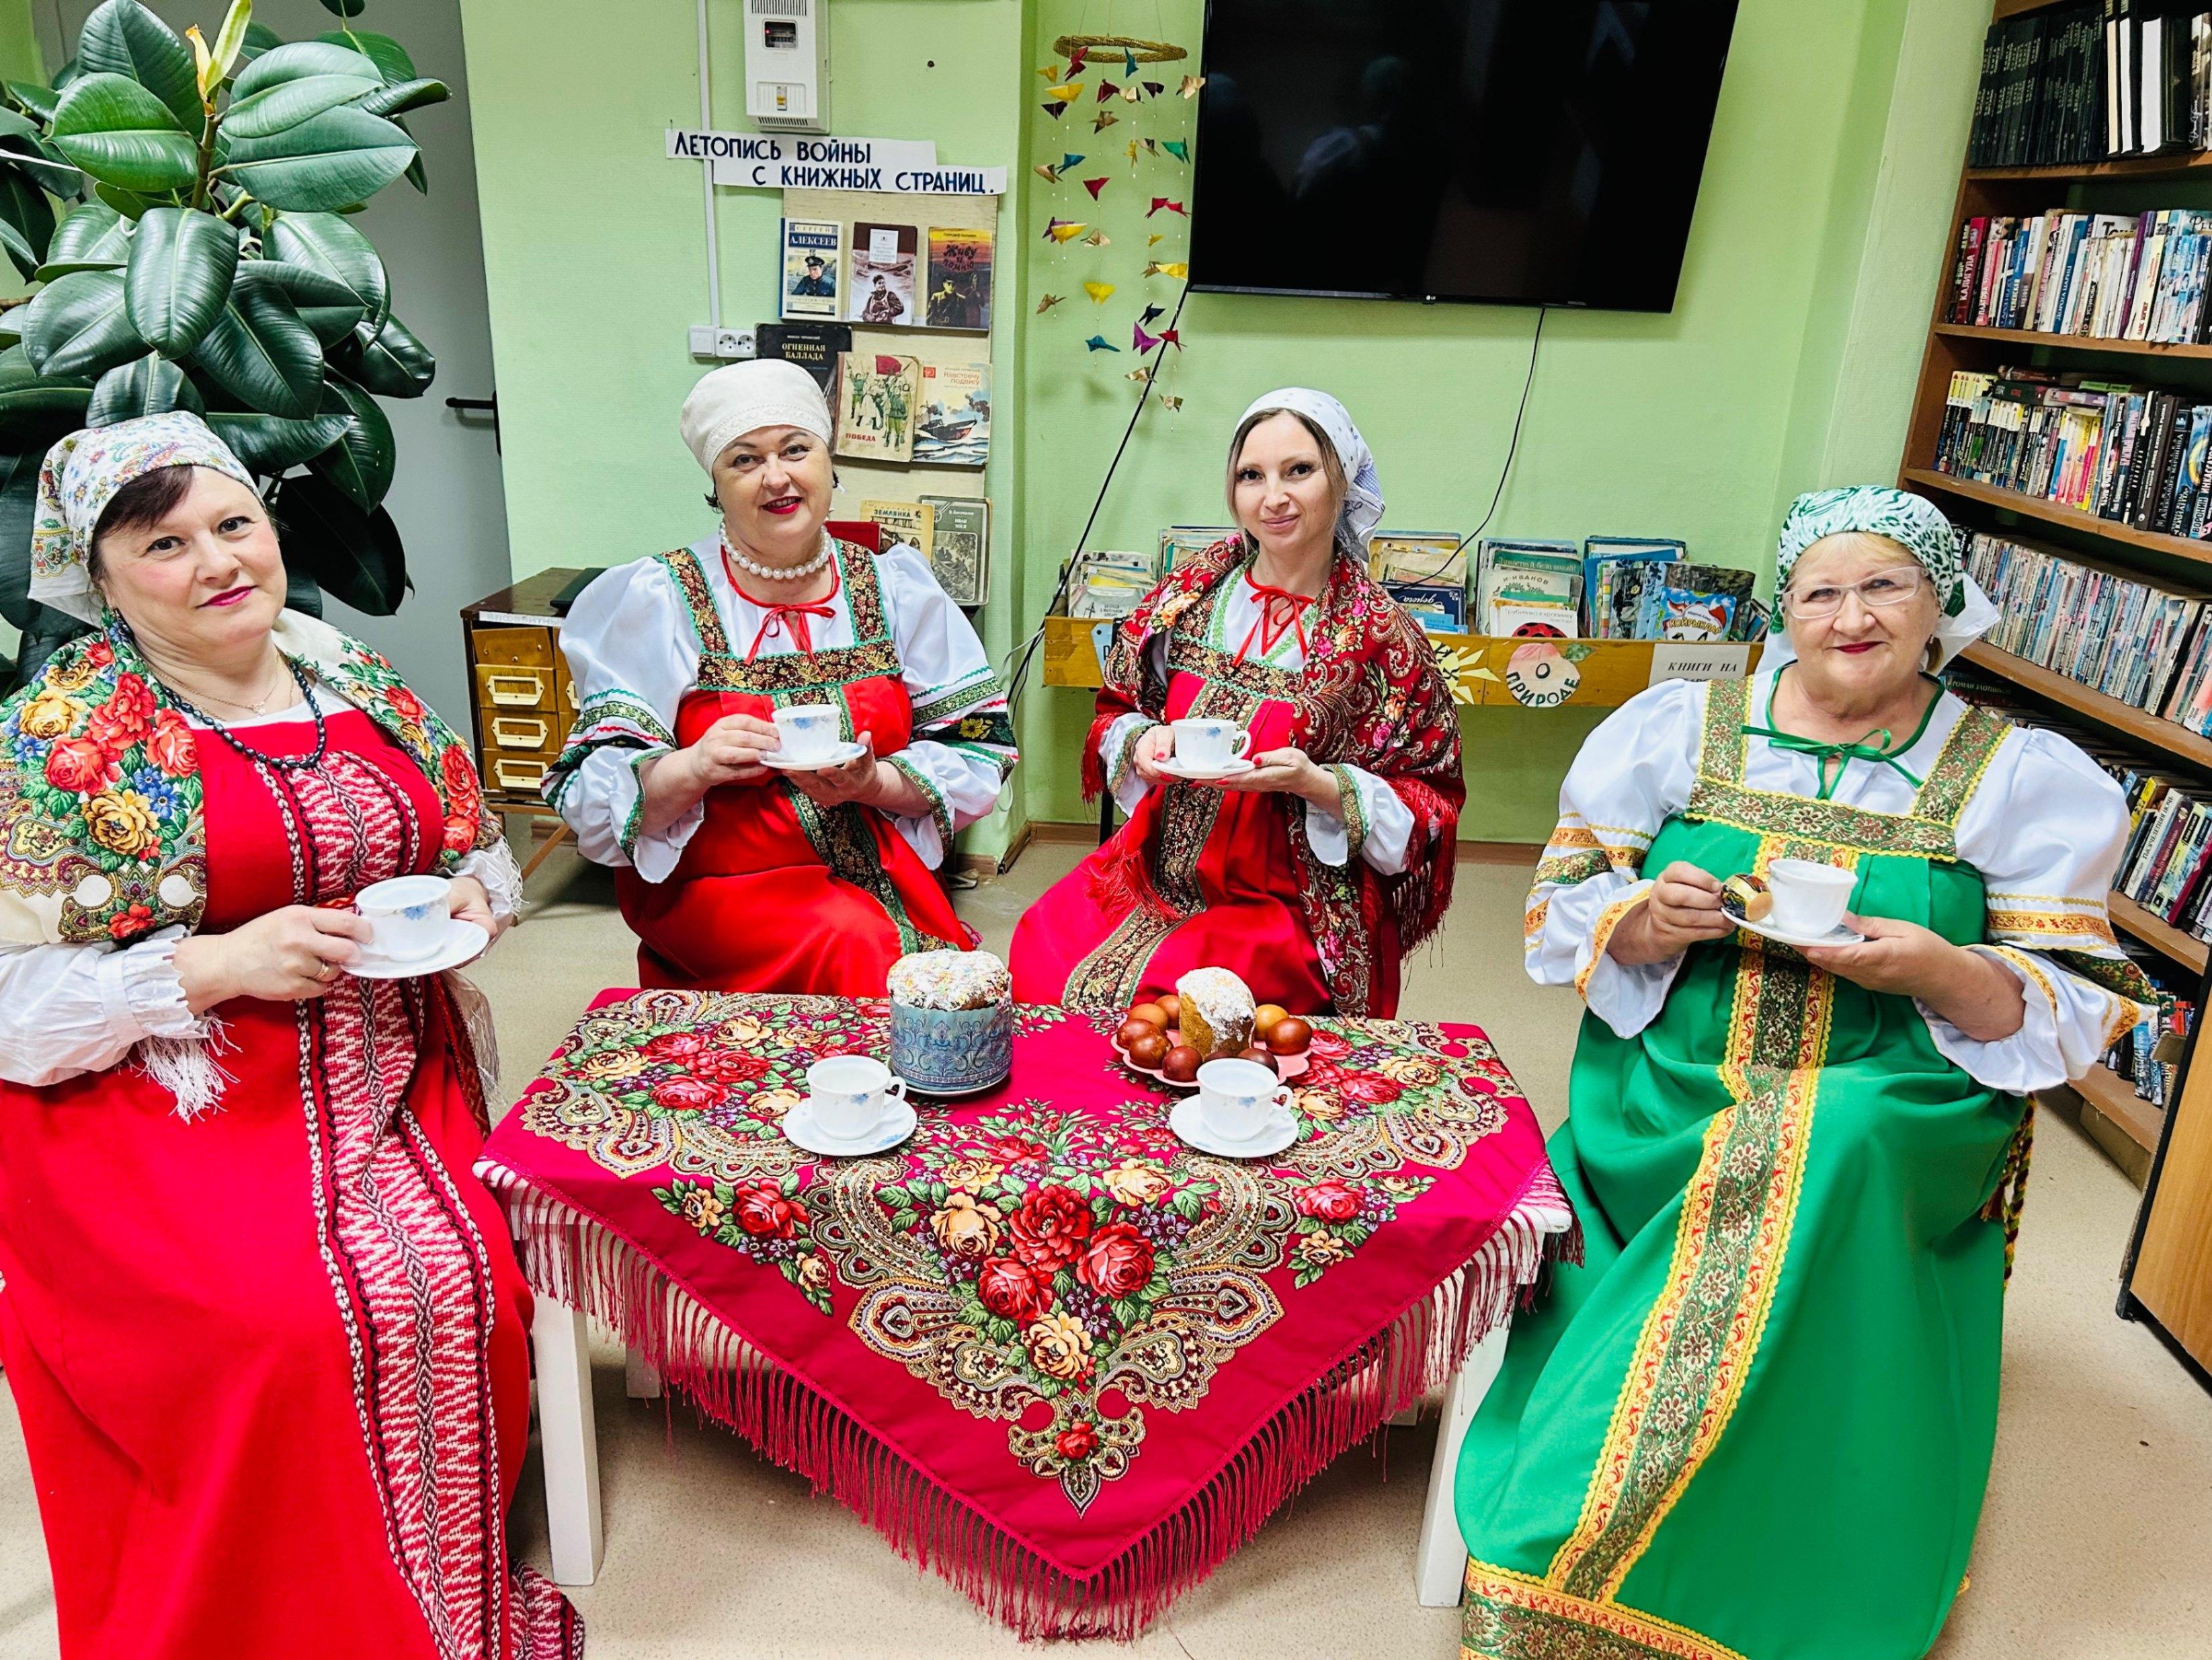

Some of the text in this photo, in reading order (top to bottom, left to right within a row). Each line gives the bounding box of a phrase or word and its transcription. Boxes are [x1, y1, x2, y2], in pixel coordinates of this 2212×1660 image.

[675, 132, 870, 163] ЛЕТОПИСЬ ВОЙНЫ
[752, 165, 995, 194] С КНИЖНЫХ СТРАНИЦ.
[790, 235, 836, 246] АЛЕКСЕЕВ
[1960, 253, 1975, 301] КАЛИГУЛА
[782, 343, 825, 352] ОГНЕННАЯ
[786, 352, 823, 361] БАЛЛАДА
[846, 433, 876, 442] ПОБЕДА
[874, 509, 911, 518] ЗЕМЛЯНКА
[2192, 498, 2207, 532] ВОРОНИН
[1535, 663, 1551, 679] О
[1668, 662, 1737, 672] КНИГИ НА
[1506, 671, 1581, 706] ПРИРОДЕ
